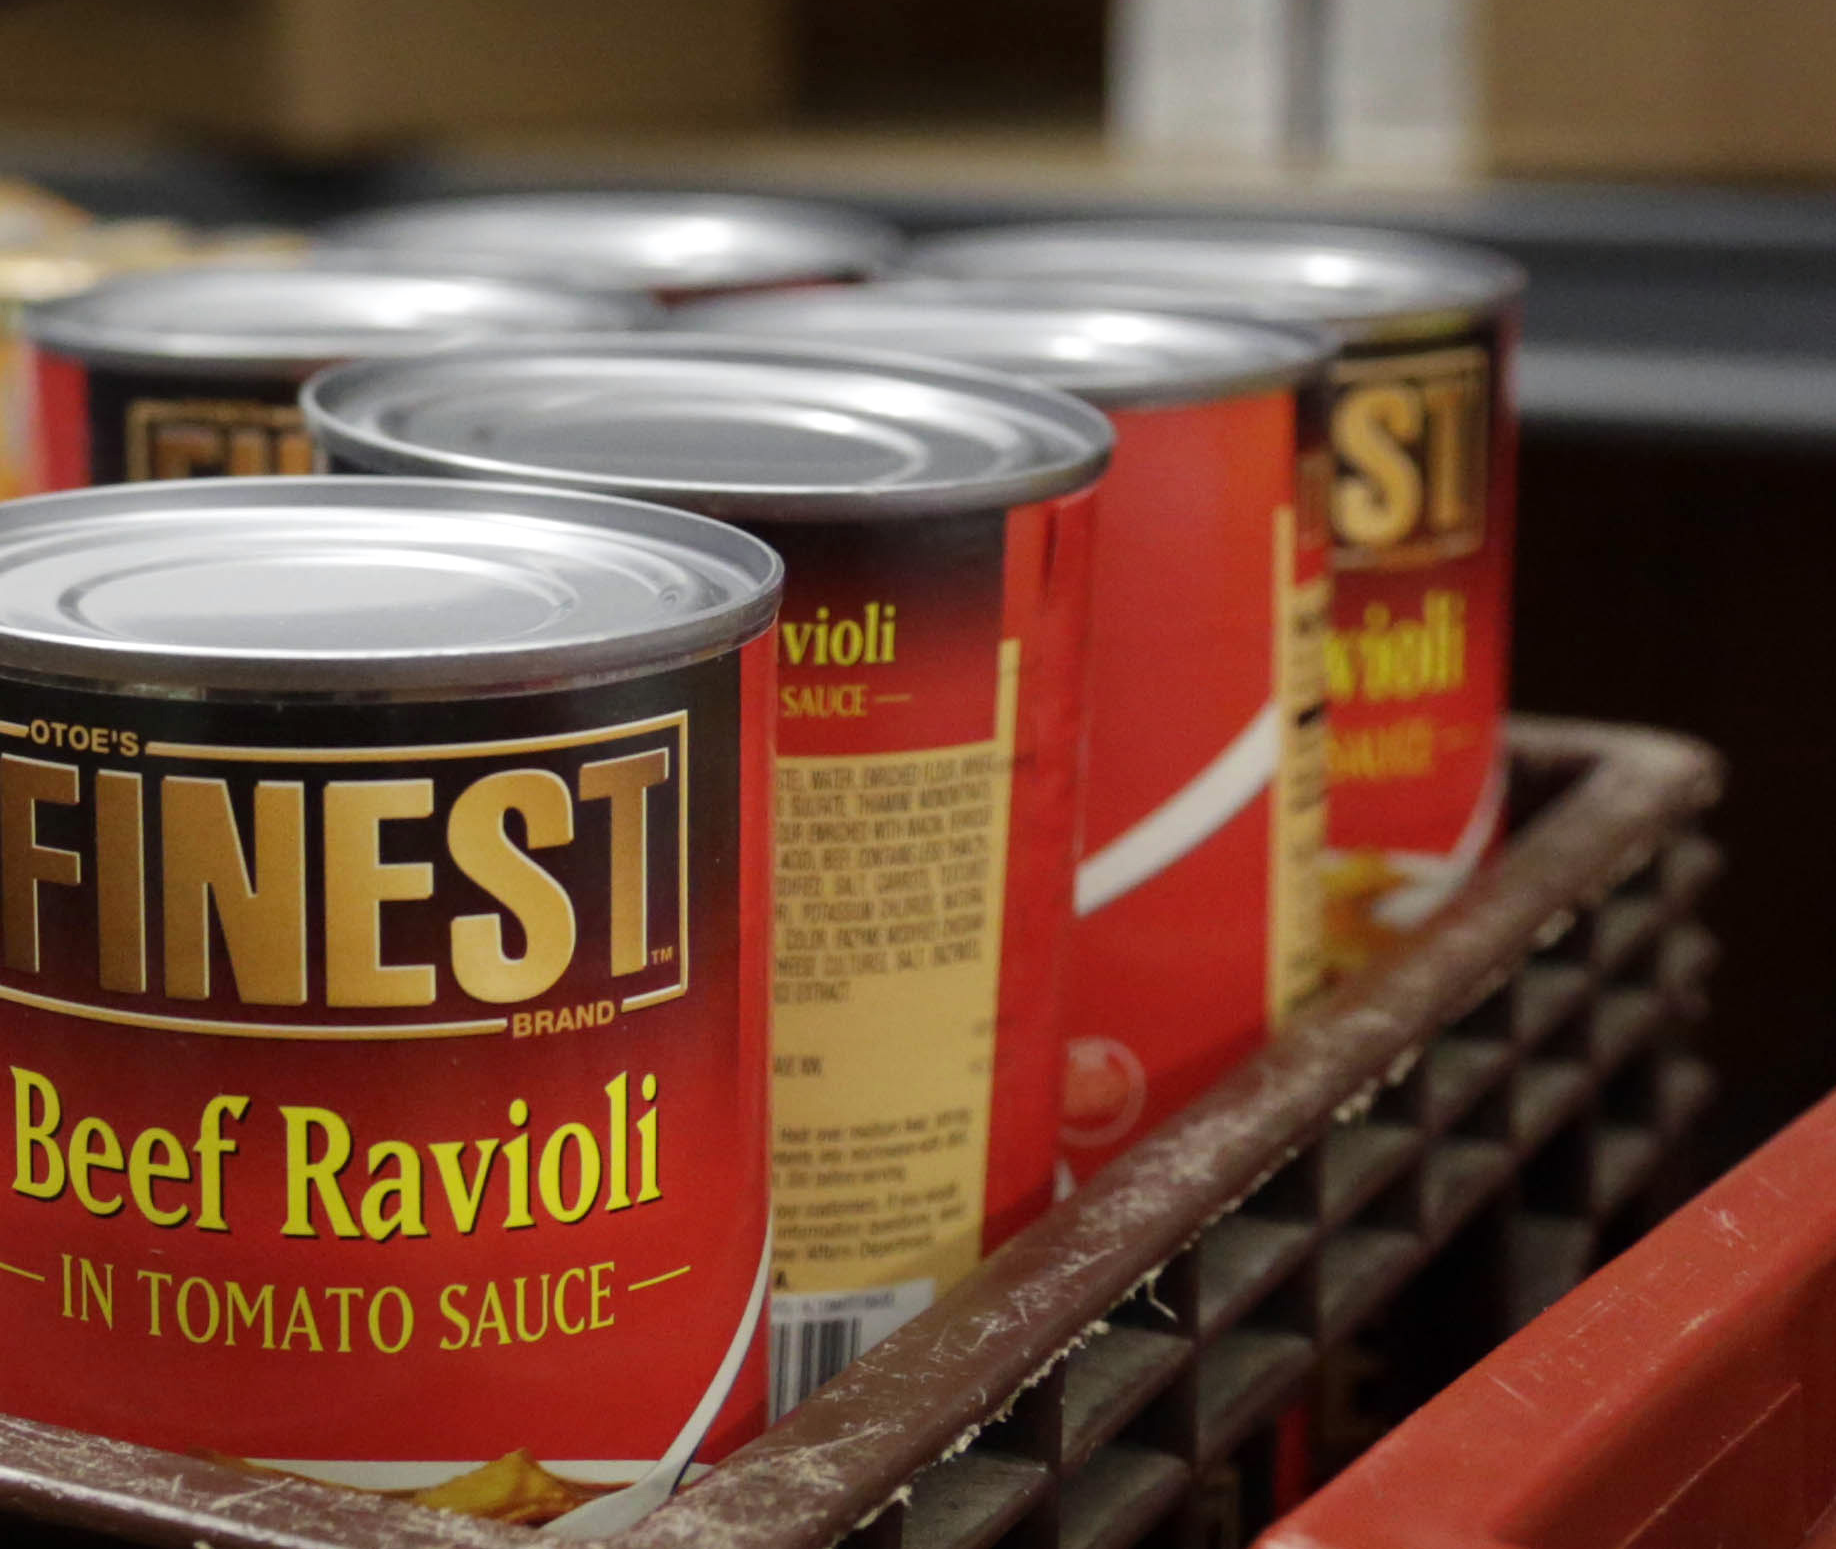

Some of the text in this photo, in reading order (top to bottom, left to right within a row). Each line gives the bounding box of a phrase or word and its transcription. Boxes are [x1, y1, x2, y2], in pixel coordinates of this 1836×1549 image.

[782, 602, 896, 666] violi
[781, 684, 869, 718] SAUCE
[30, 719, 139, 757] OTOE'S
[0, 747, 669, 1008] FINEST
[511, 1000, 616, 1039] BRAND
[9, 1065, 662, 1242] Beef Ravioli
[60, 1254, 616, 1354] IN TOMATO SAUCE
